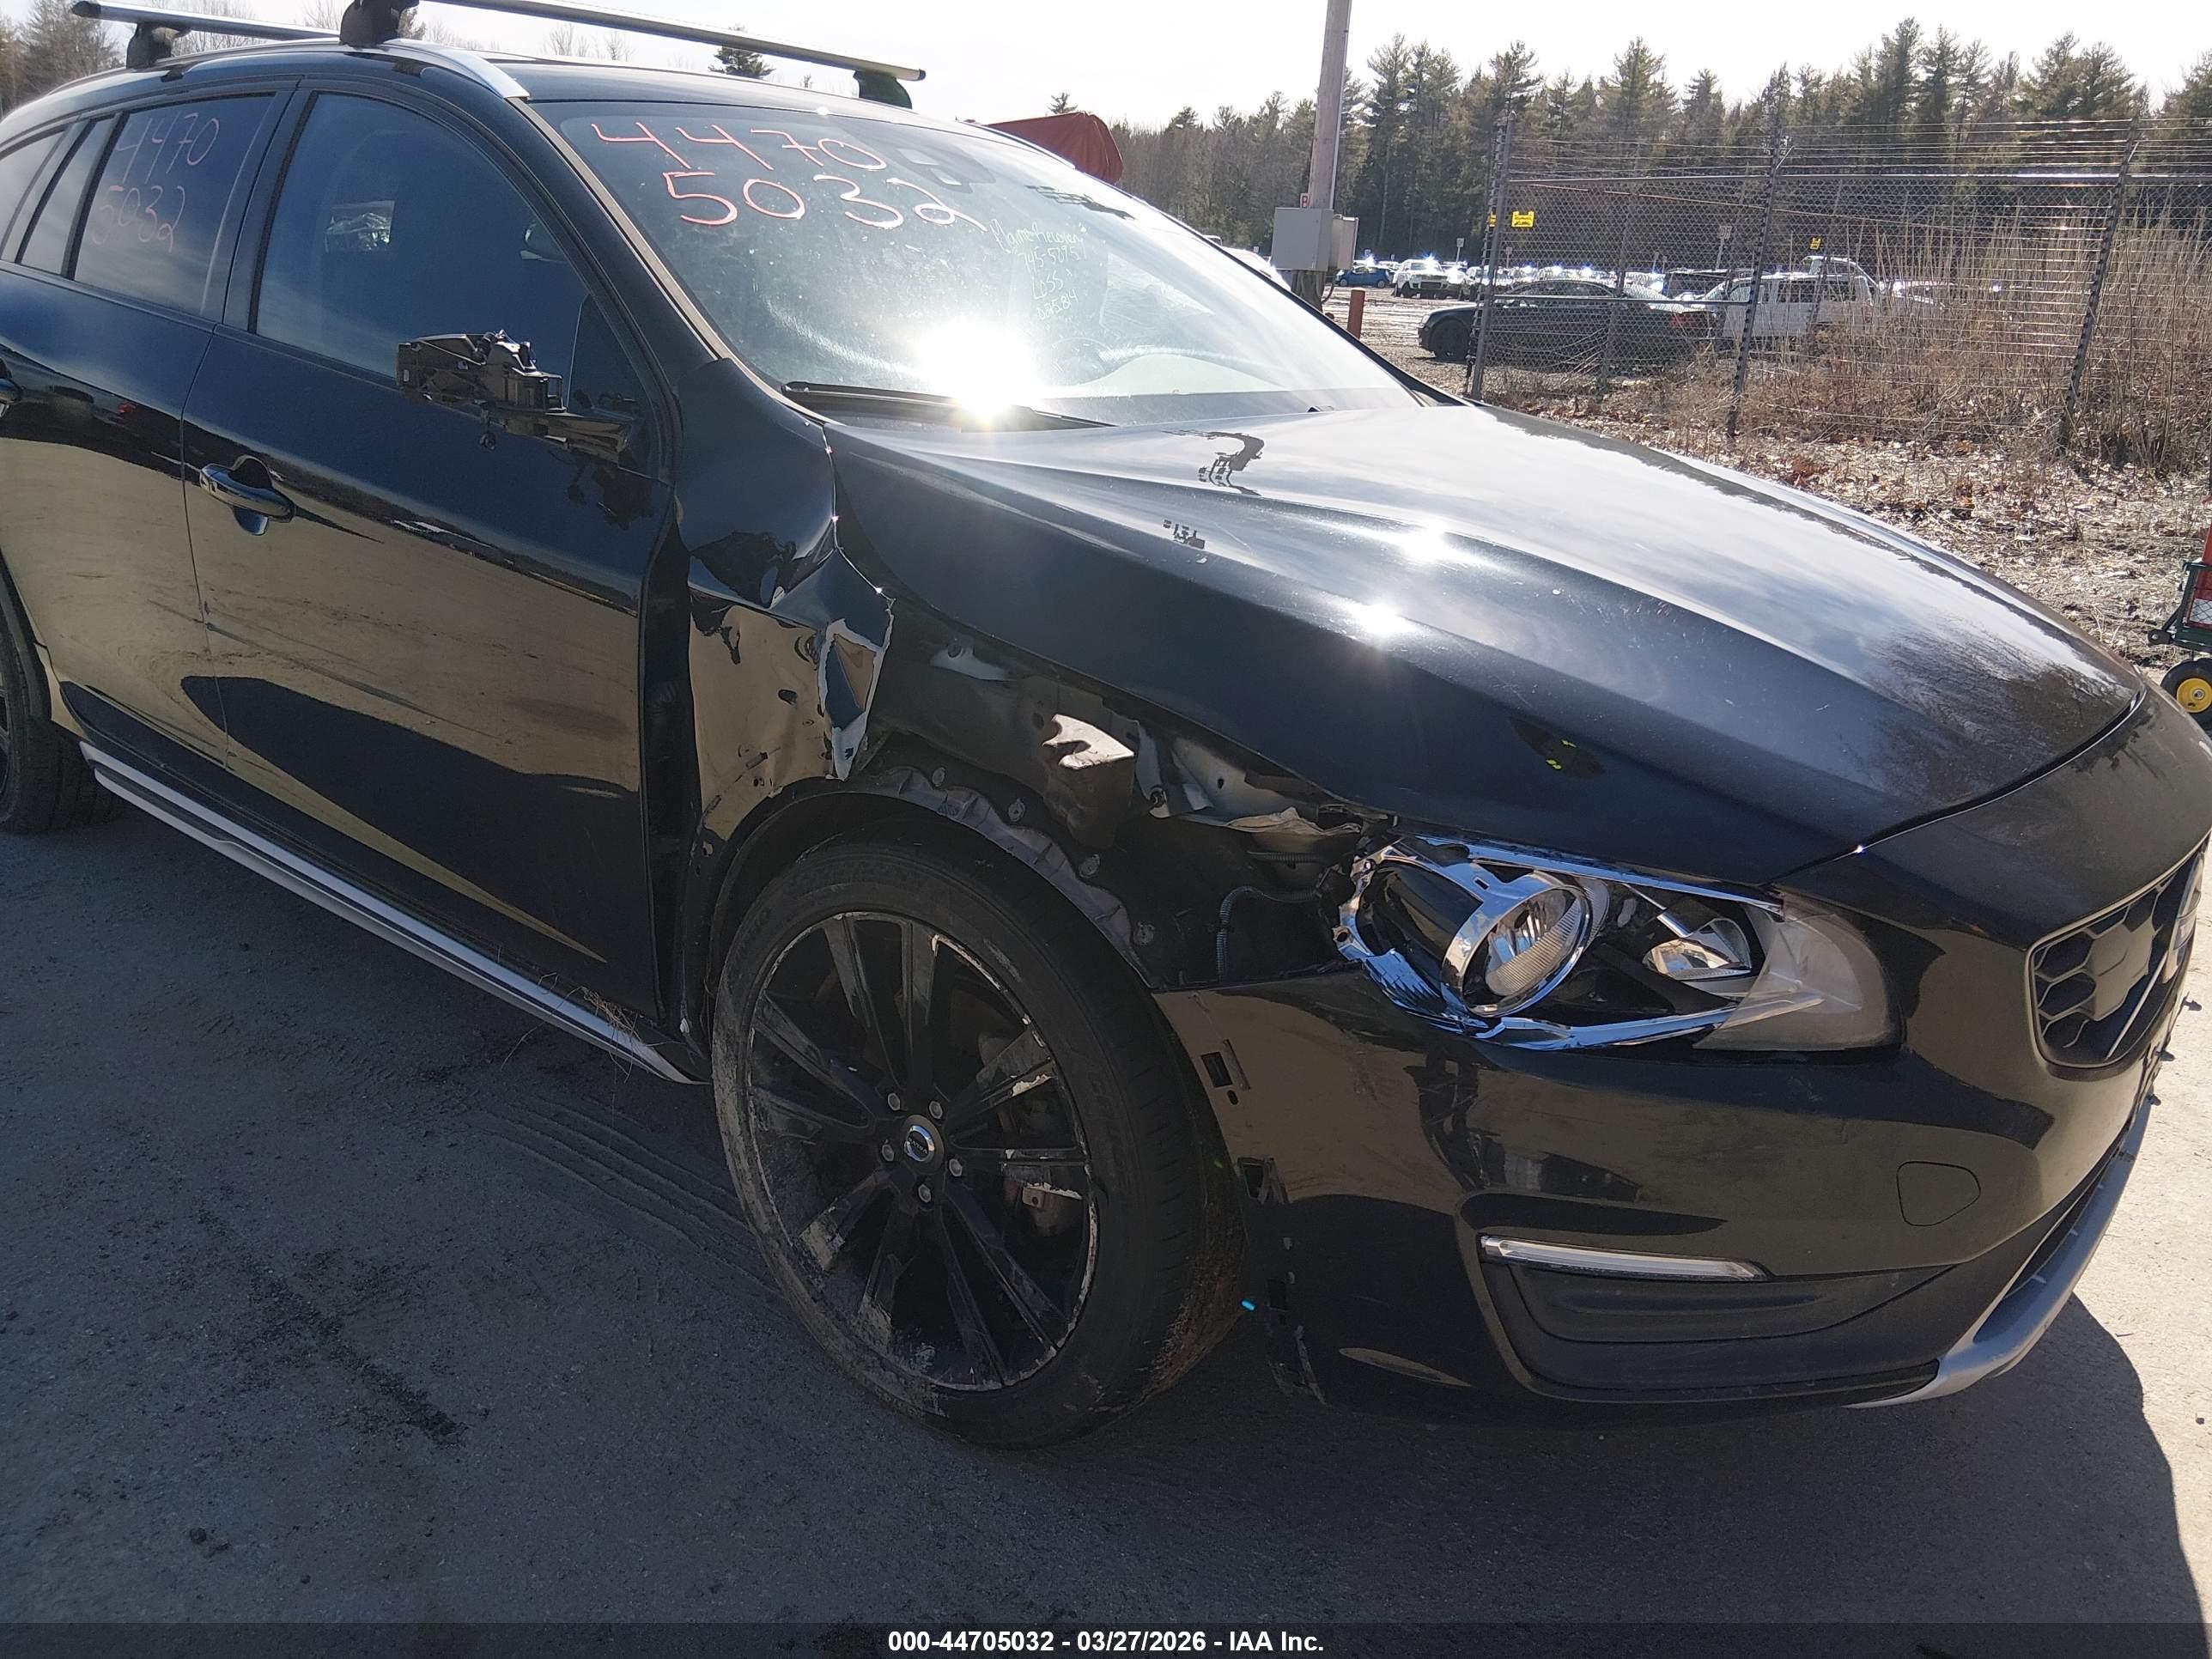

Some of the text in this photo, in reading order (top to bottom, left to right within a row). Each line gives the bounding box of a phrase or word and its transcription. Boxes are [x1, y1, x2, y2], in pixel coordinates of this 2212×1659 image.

[115, 111, 220, 185] 4470
[591, 121, 887, 170] 4470
[90, 185, 186, 252] 5032
[663, 171, 988, 231] 5032
